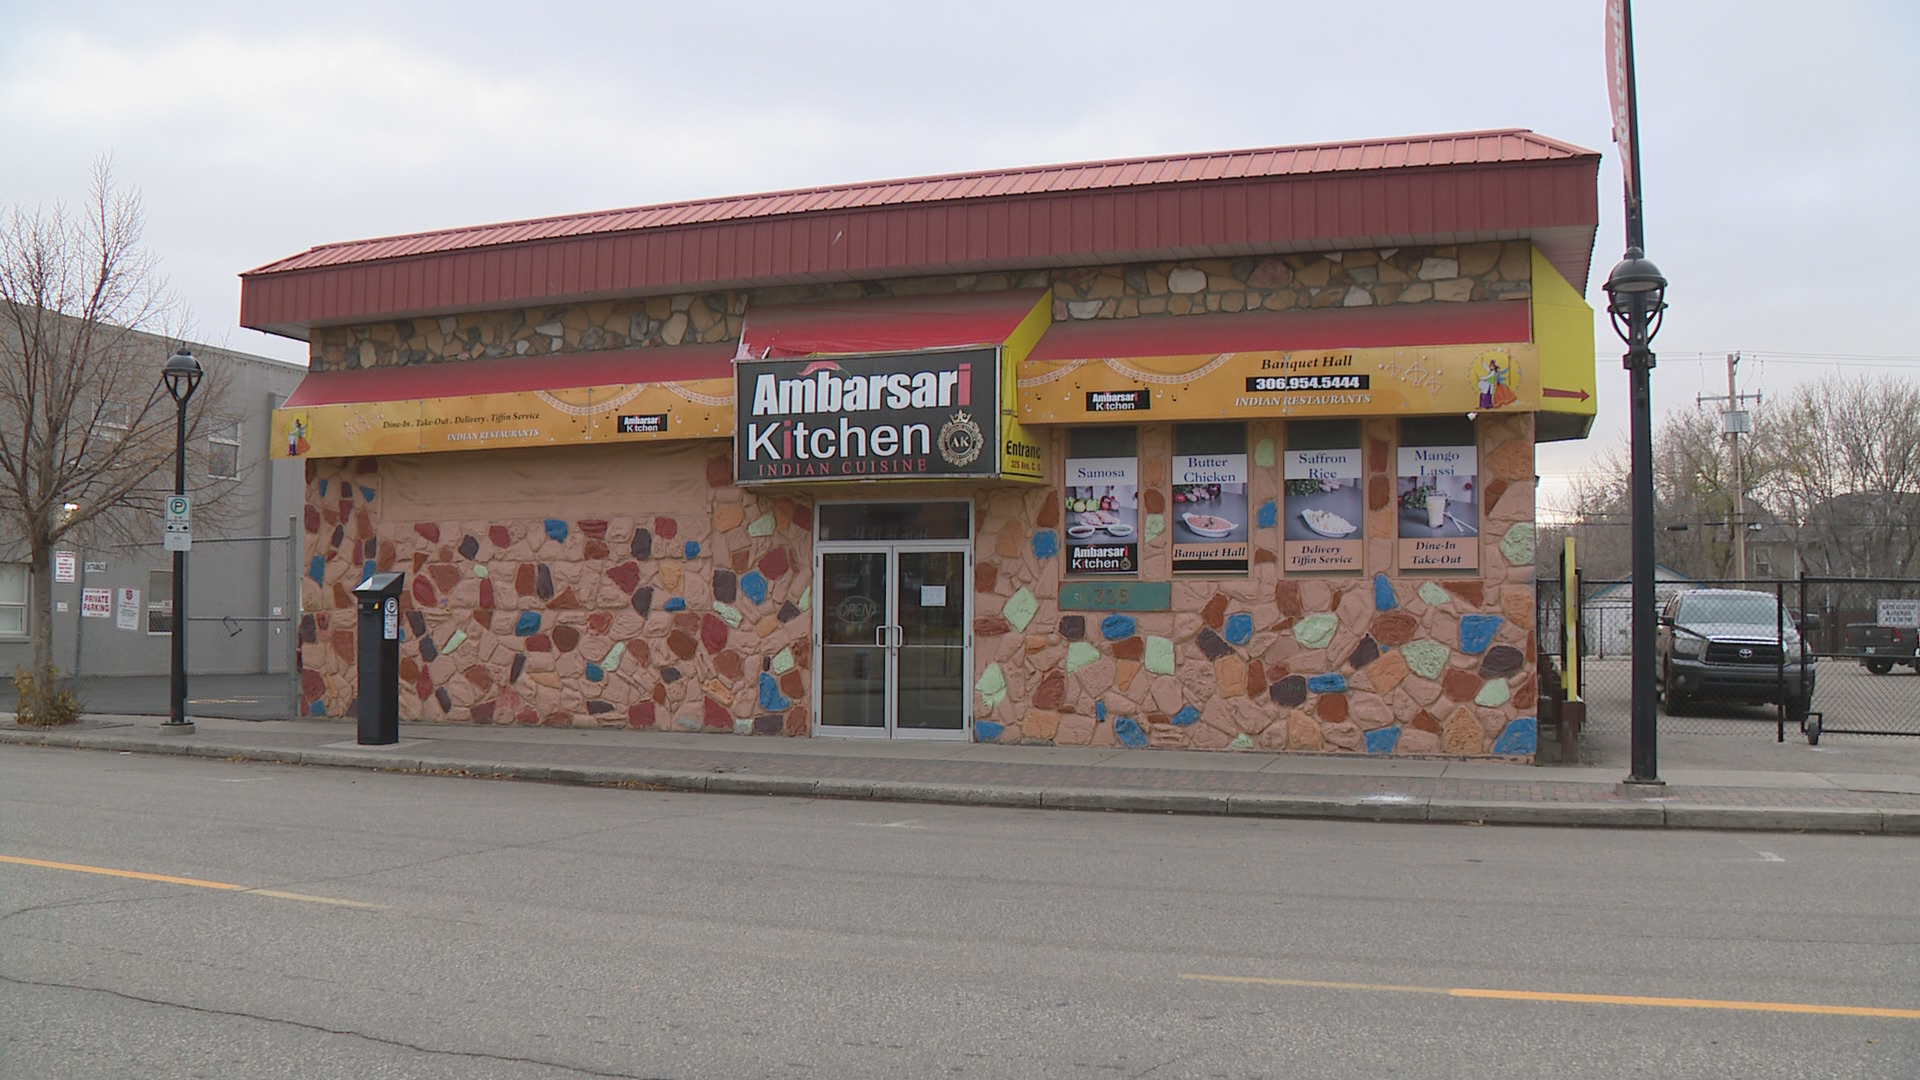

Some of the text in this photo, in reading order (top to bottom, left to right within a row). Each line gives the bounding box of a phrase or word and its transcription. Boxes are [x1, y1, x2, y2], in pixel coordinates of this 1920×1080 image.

[1261, 355, 1352, 372] Banquet Hall
[1255, 376, 1360, 390] 306.954.5444
[752, 363, 972, 416] Ambarsari
[1092, 392, 1138, 403] Ambarsari
[1235, 394, 1371, 408] INDIAN RESTAURANTS
[383, 420, 410, 429] Dine-In
[416, 417, 449, 427] Take-Out
[454, 415, 486, 425] Delivery
[513, 411, 540, 421] Service
[624, 415, 661, 425] Ambarsari
[447, 429, 540, 441] INDIAN RESTAURANTS
[748, 417, 931, 461] Kitchen
[1299, 453, 1347, 464] Saffron
[1414, 450, 1460, 462] Mango
[758, 459, 928, 477] INDIAN CUISINE
[1188, 457, 1228, 468] Butter
[1078, 468, 1125, 479] Samosa
[1309, 468, 1337, 479] Rice
[1420, 465, 1455, 476] Lassi
[1184, 471, 1236, 482] Chicken
[1073, 545, 1128, 558] Ambarsari
[1301, 545, 1341, 555] Delivery
[1416, 541, 1456, 551] Dine-In
[1174, 547, 1245, 560] Banquet Hall
[1072, 558, 1119, 569] Kitchen
[1291, 555, 1352, 567] Tiffin Service
[1411, 555, 1461, 565] Take-Out
[85, 594, 109, 604] PRIVATE
[83, 603, 109, 613] PARKING
[838, 603, 872, 617] OPEN
